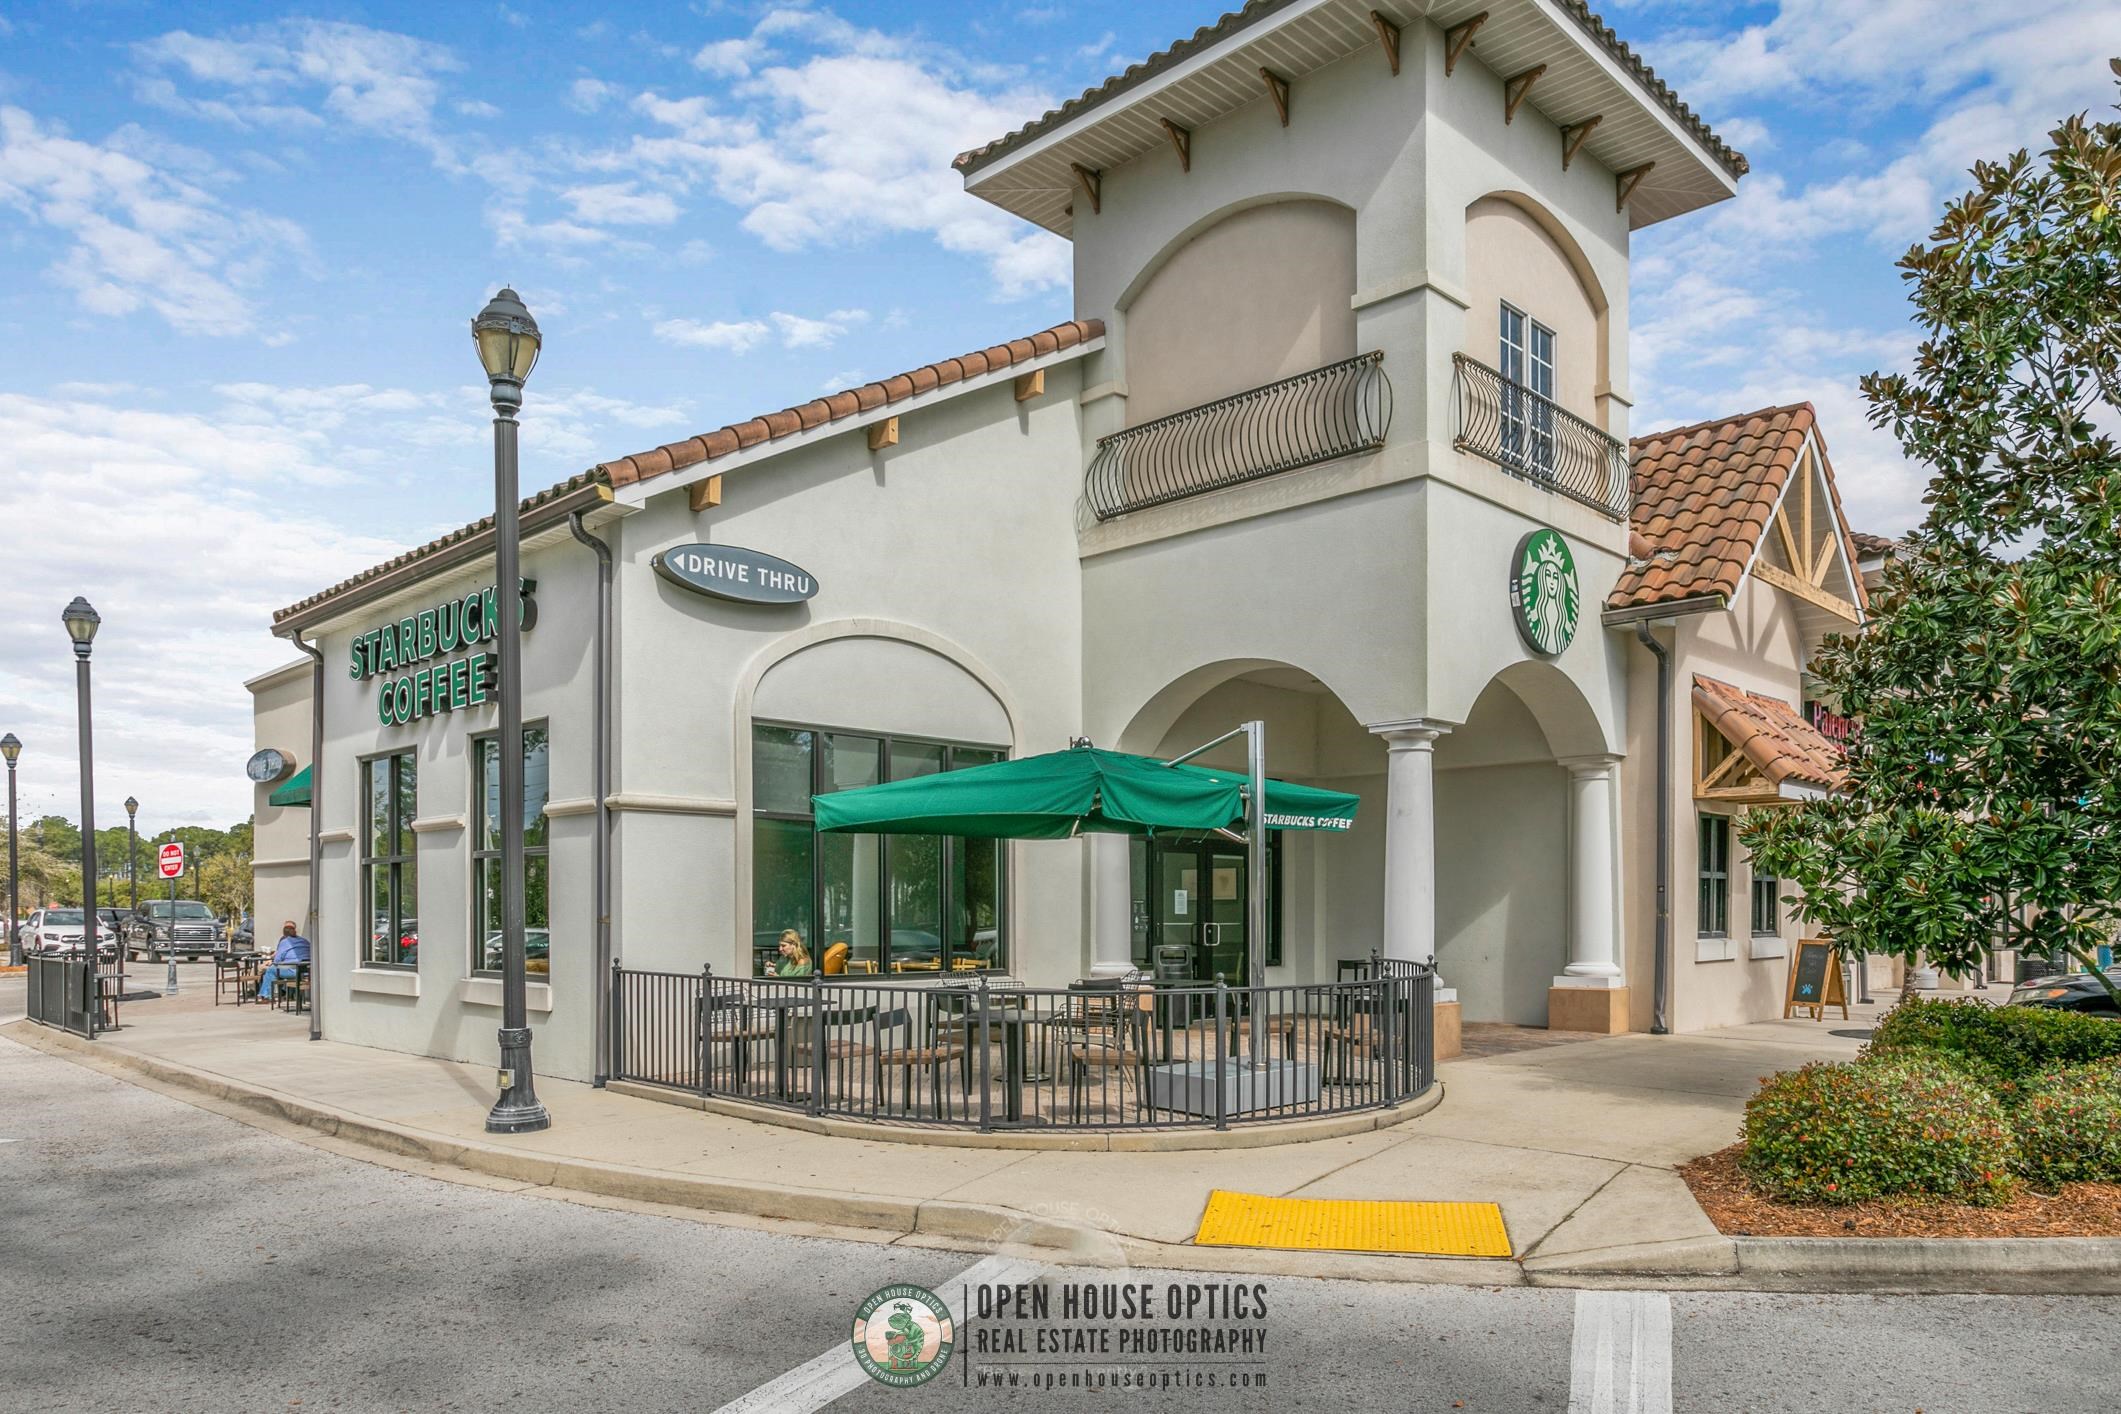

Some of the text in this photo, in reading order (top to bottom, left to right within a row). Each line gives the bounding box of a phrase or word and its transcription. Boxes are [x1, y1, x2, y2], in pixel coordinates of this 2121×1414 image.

[689, 554, 809, 594] DRIVE THRU
[350, 577, 524, 681] STARBUCK
[378, 652, 487, 727] COFFEE
[1263, 814, 1315, 827] STARBUCKS
